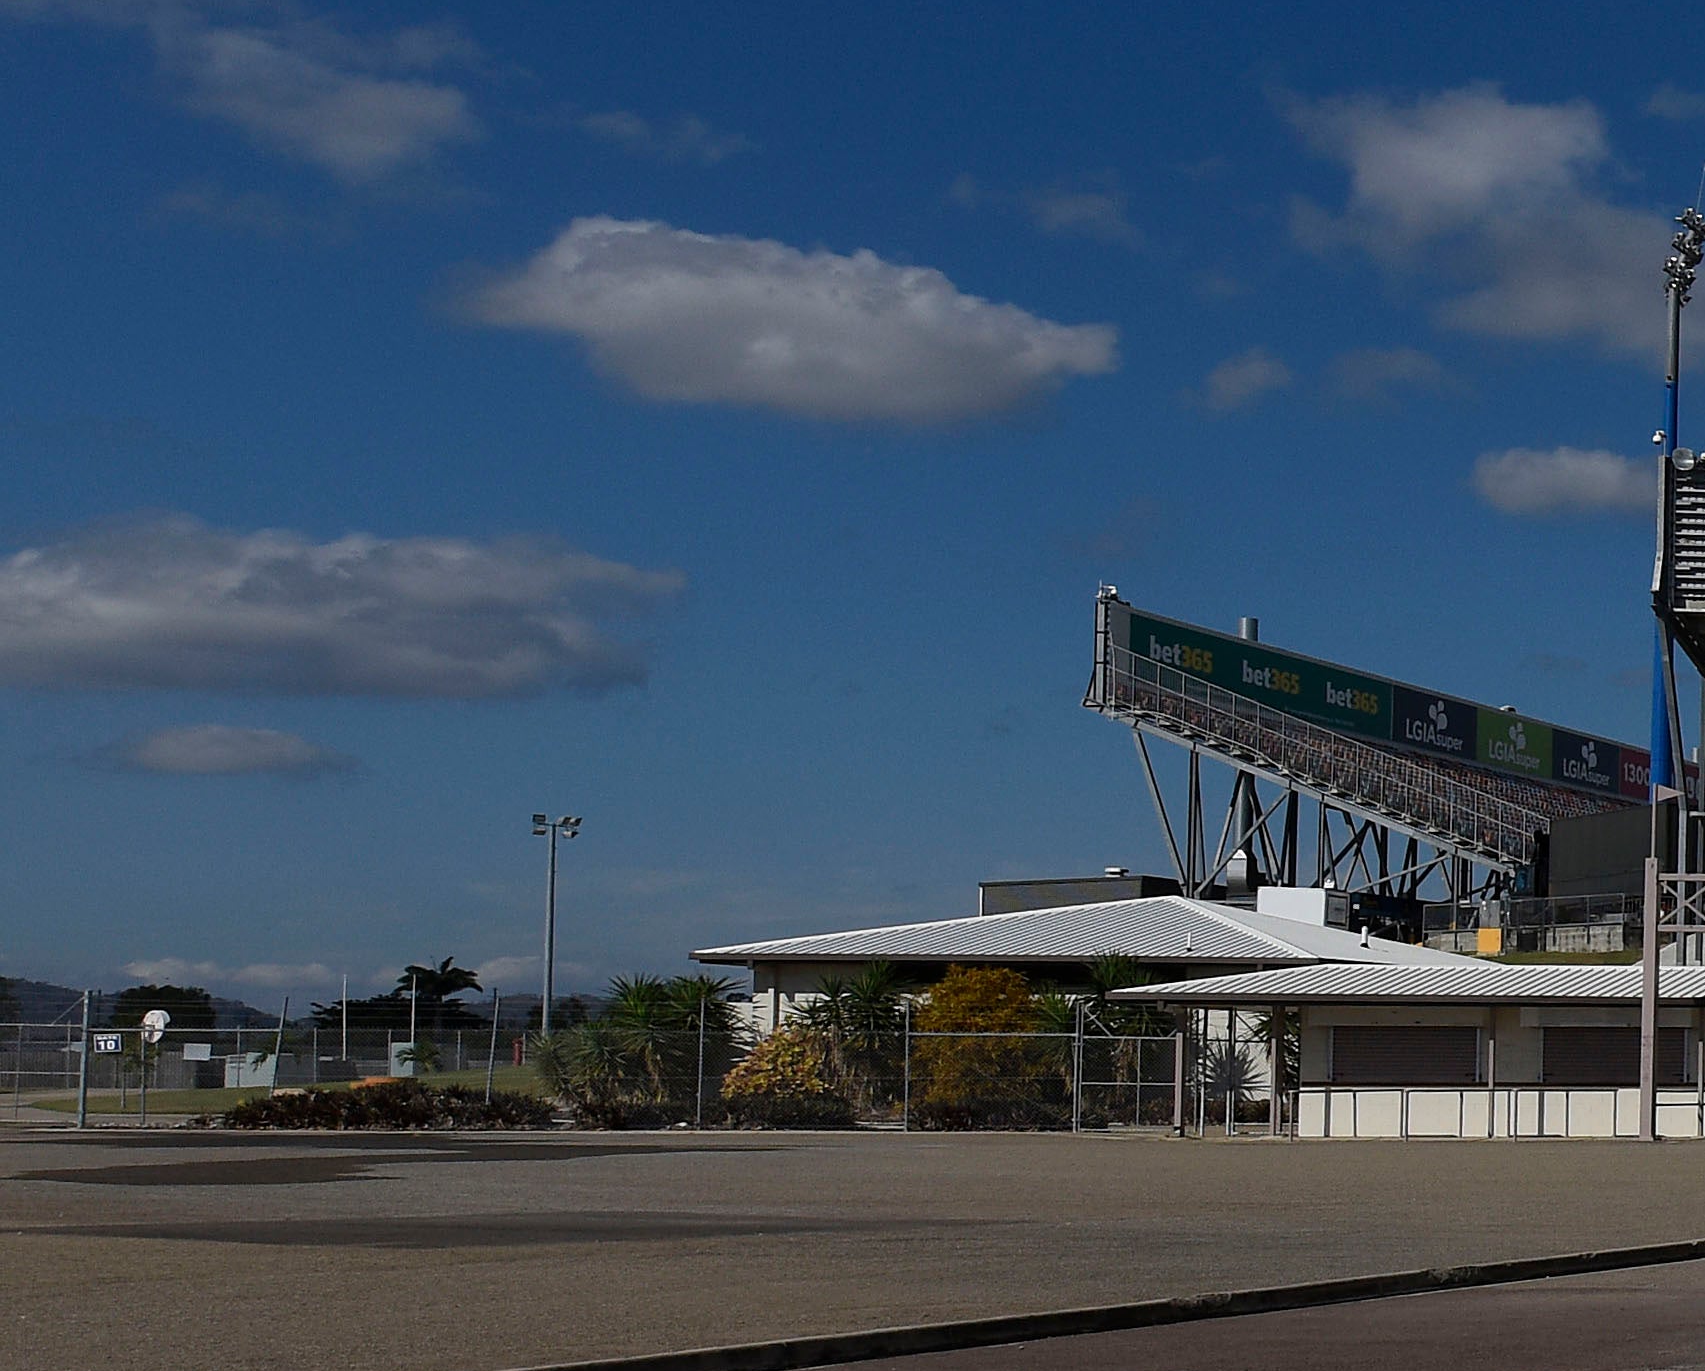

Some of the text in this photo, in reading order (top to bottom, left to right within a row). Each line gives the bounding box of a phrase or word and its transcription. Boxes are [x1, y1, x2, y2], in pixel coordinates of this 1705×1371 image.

[1150, 635, 1213, 674] bet365
[1242, 660, 1300, 695] bet365
[1326, 681, 1378, 715] bet365
[98, 1040, 116, 1050] 10
